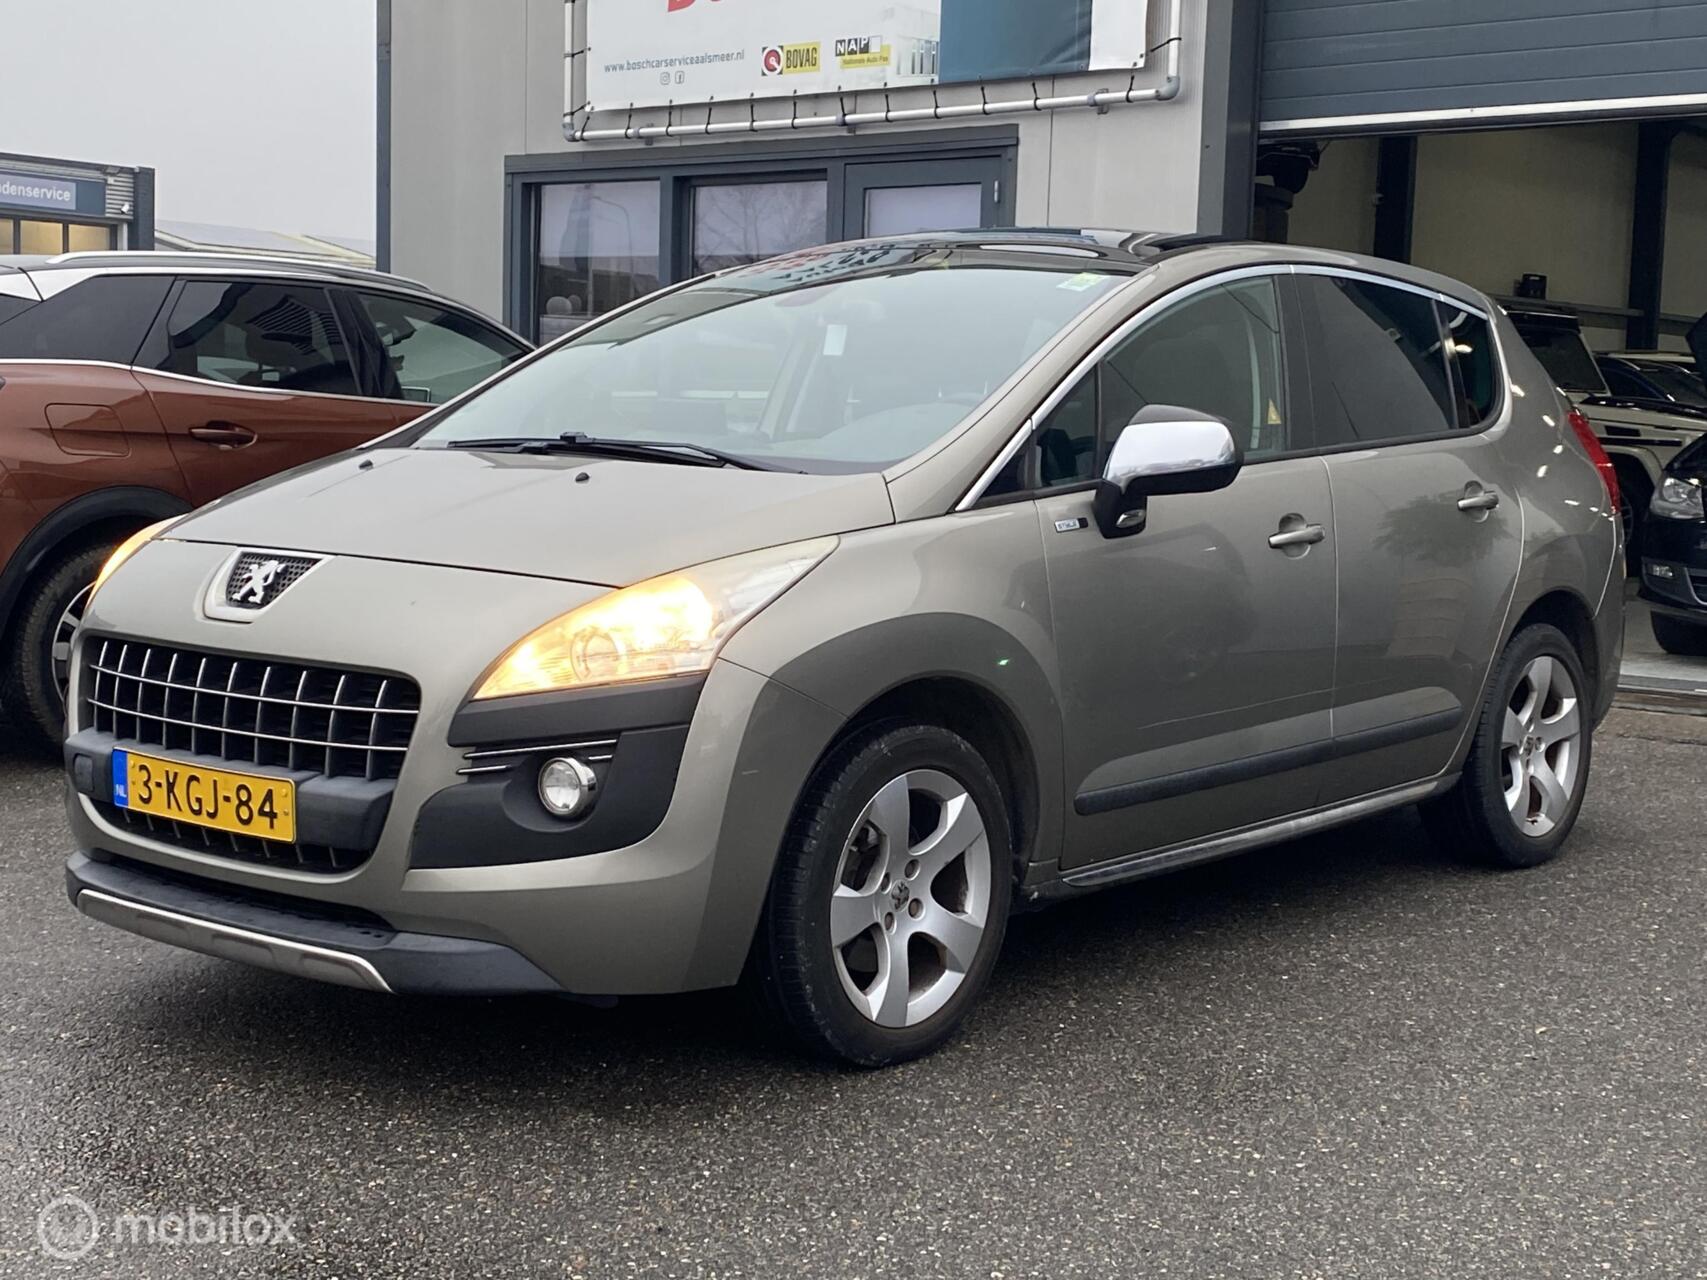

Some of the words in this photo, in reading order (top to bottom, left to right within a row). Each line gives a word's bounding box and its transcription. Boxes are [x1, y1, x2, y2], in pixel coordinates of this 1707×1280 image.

[836, 36, 869, 56] NAP
[604, 50, 745, 72] www.boschcarserviceaalsmeer.nl
[785, 47, 818, 68] BOVAG
[138, 764, 278, 829] 3-KGJ-84
